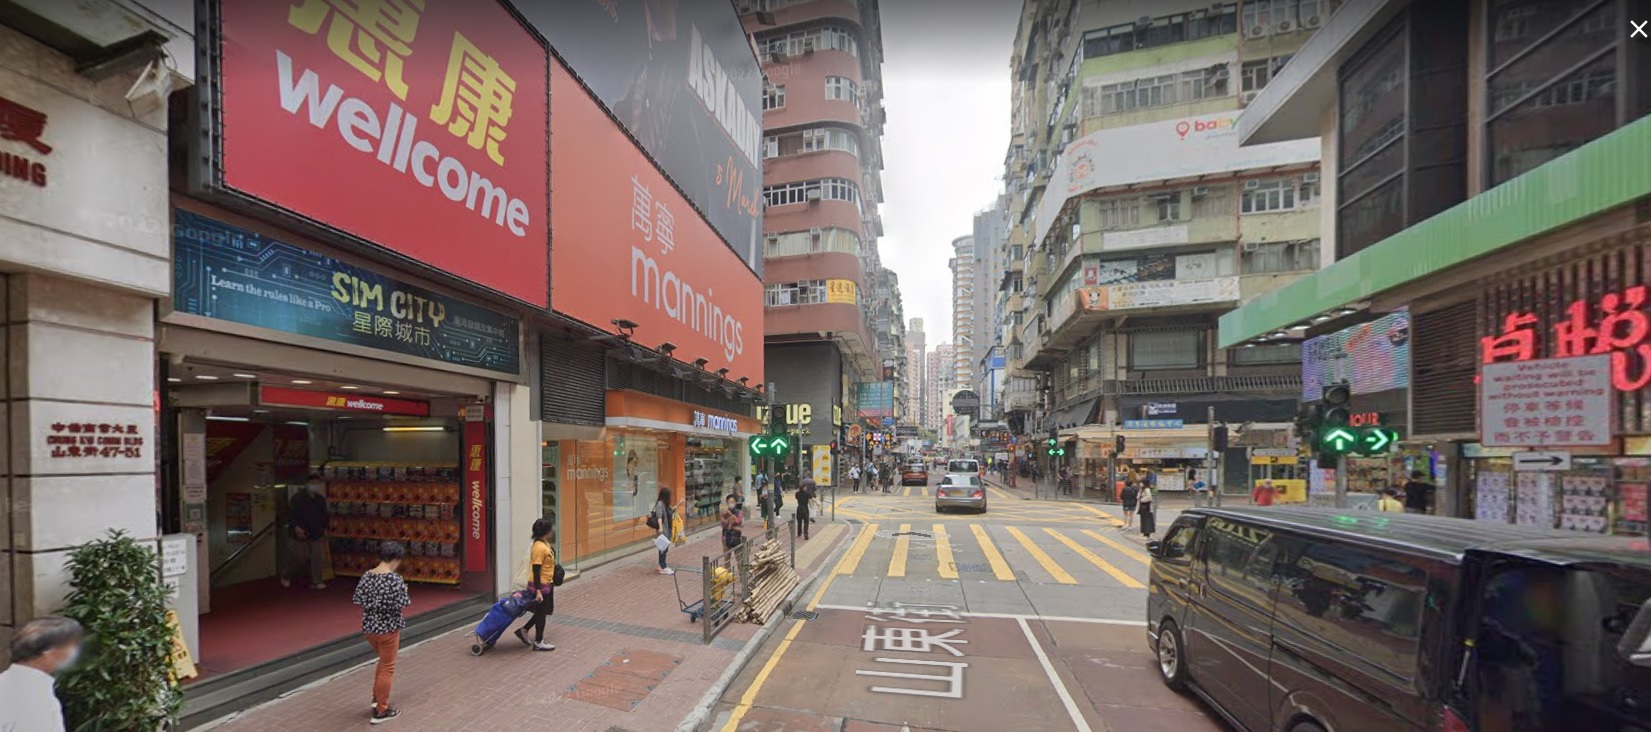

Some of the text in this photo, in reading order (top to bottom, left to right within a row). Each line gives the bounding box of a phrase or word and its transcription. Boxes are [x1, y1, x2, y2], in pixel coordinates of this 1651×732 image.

[276, 49, 531, 237] wellcome
[631, 174, 676, 256] 萬寧
[211, 274, 245, 292] Learn
[245, 282, 262, 296] the
[264, 290, 288, 302] rules
[289, 293, 307, 306] like
[315, 301, 331, 312] Pro
[331, 271, 446, 327] SIM CITY
[631, 245, 744, 362] mannings
[353, 311, 431, 346] 星際城市
[1493, 373, 1541, 382] waiting
[1517, 362, 1569, 371] Vehicle
[1488, 388, 1605, 400] without warning
[1503, 379, 1584, 391] prosecuted
[347, 399, 384, 410] wellcome
[707, 414, 738, 433] mannings
[567, 466, 609, 482] mannings
[472, 480, 480, 540] wellcome
